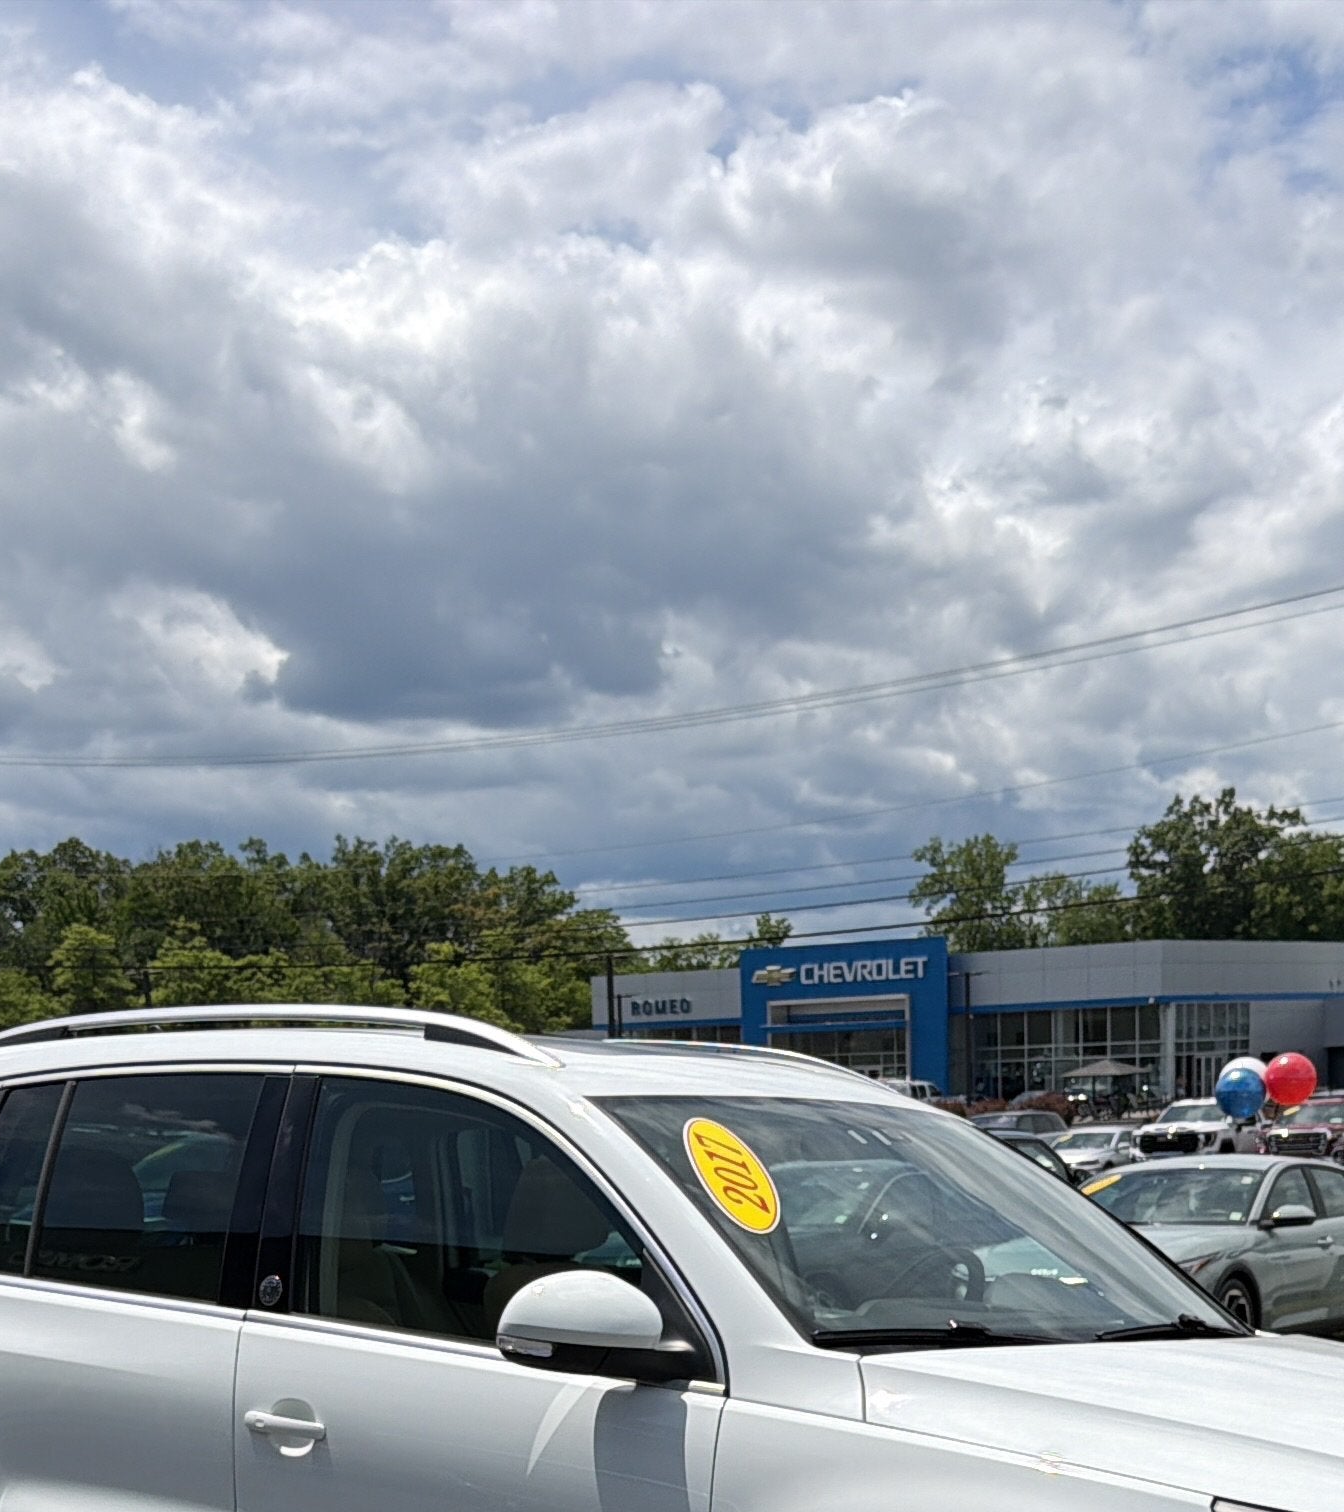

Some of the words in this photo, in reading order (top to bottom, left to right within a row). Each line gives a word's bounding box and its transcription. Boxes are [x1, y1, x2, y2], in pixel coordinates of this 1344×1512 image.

[799, 957, 929, 986] CHEVROLET
[630, 997, 692, 1017] ROMEO
[693, 1131, 771, 1215] 2017
